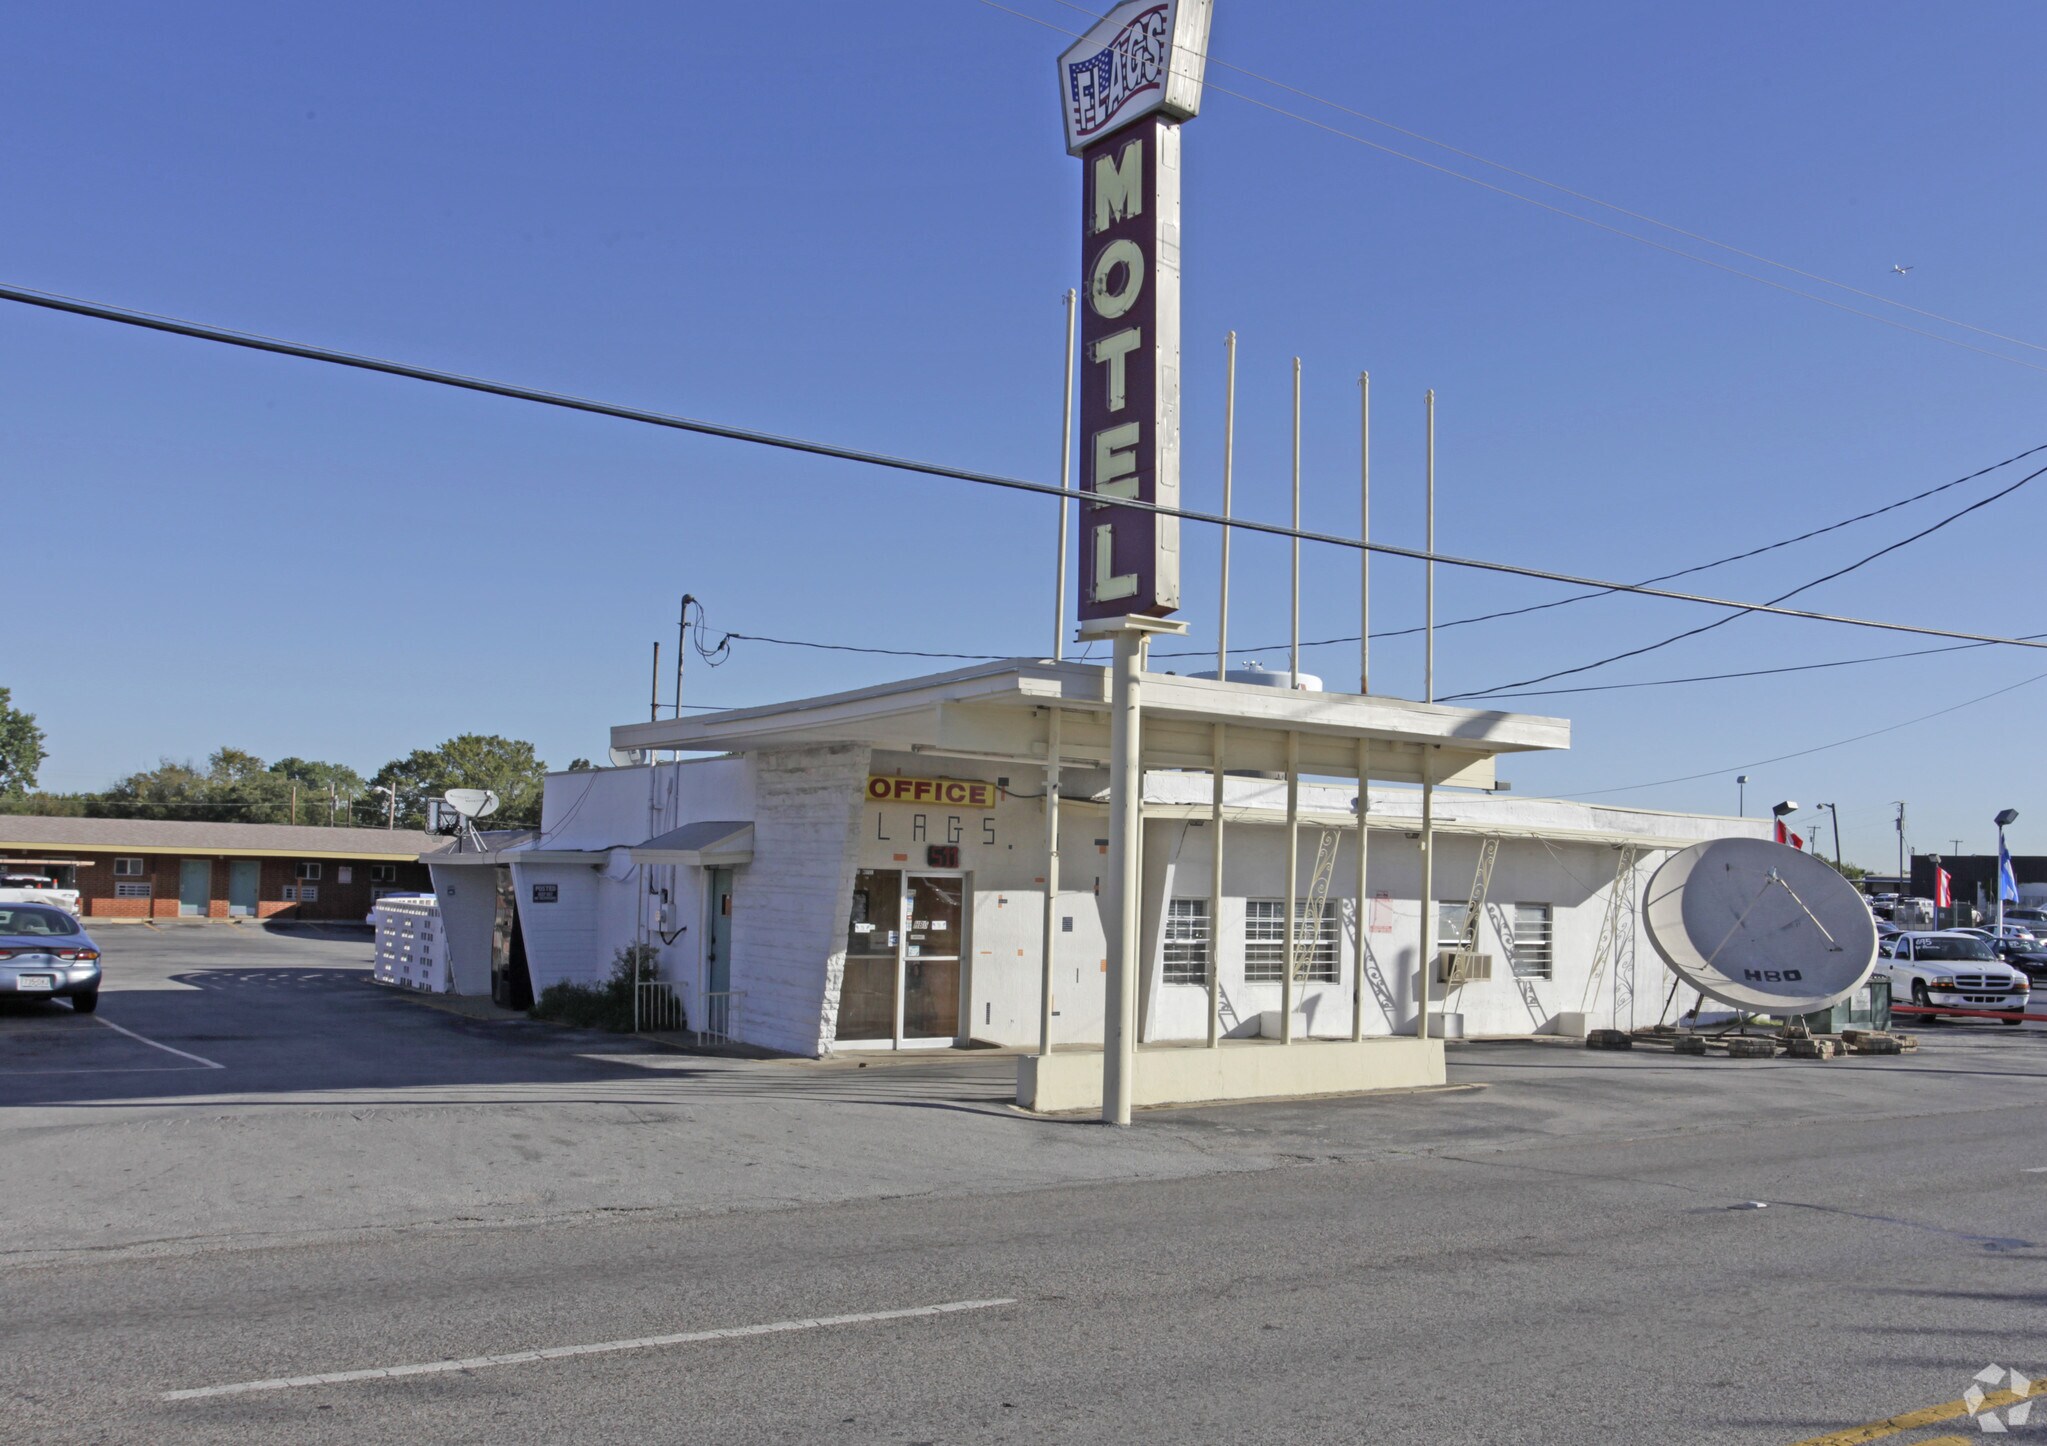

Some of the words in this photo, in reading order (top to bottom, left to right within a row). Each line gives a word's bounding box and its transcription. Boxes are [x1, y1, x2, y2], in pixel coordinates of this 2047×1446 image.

[1077, 11, 1163, 130] FLAGS
[1092, 138, 1145, 603] MOTEL
[869, 777, 987, 804] OFFICE
[1744, 968, 1802, 983] HBO
